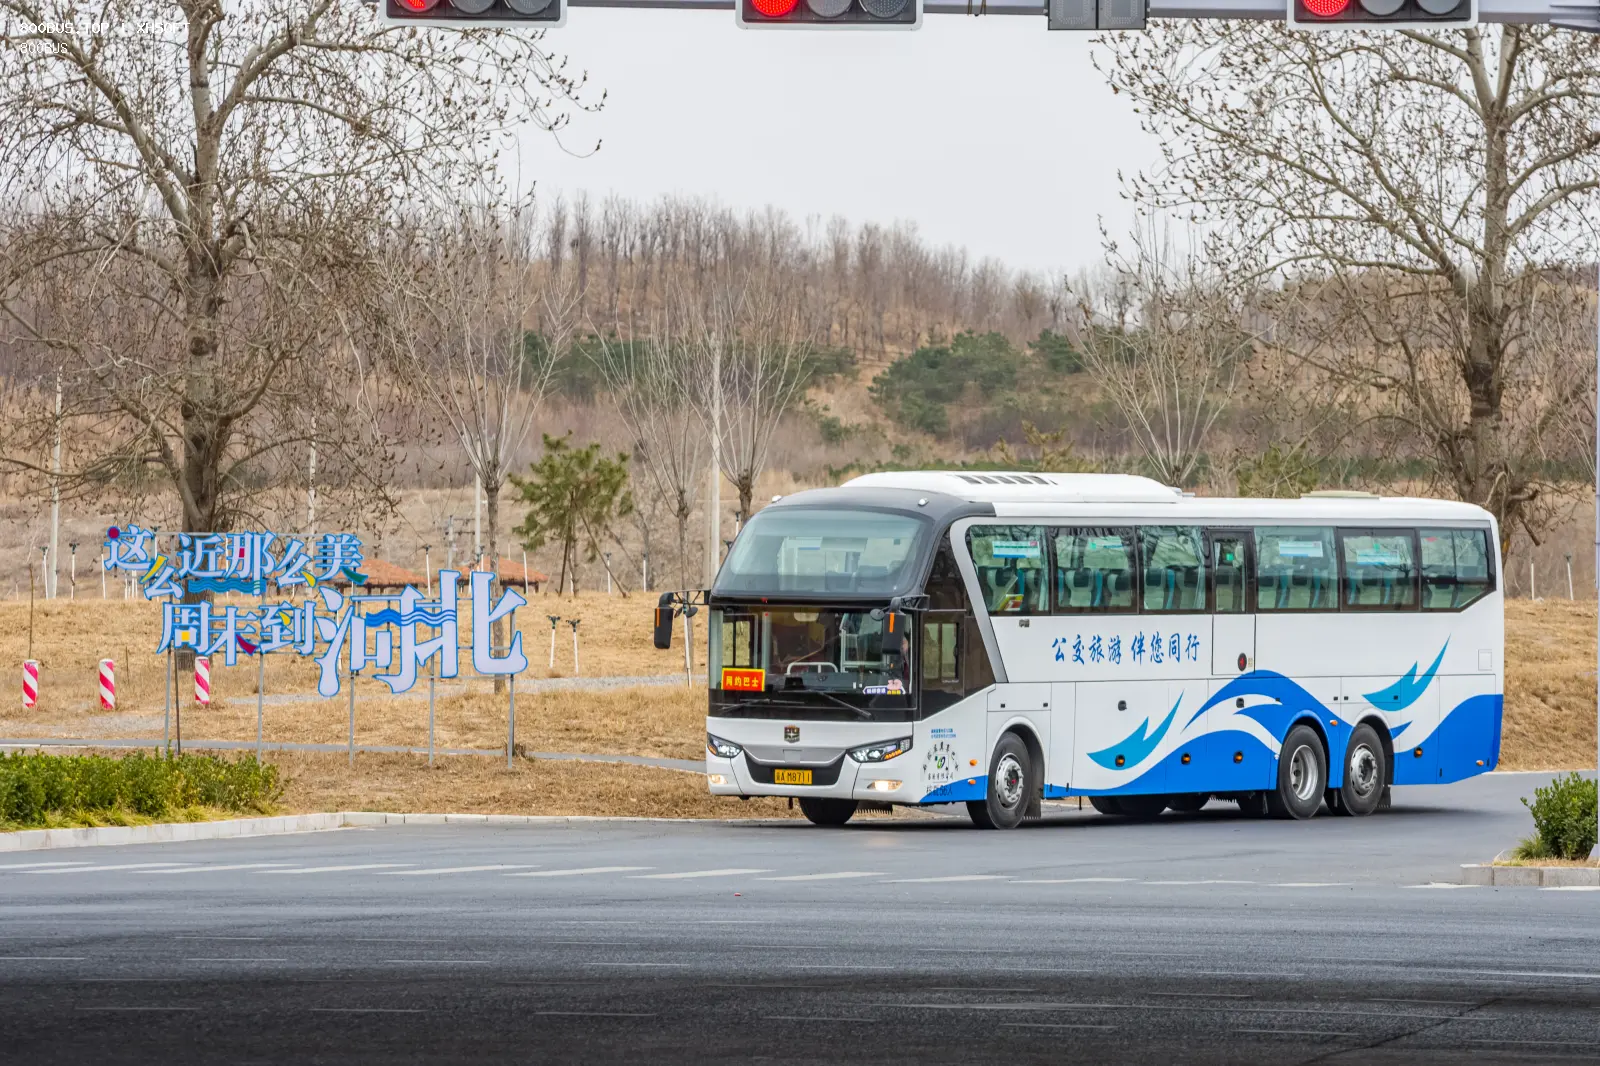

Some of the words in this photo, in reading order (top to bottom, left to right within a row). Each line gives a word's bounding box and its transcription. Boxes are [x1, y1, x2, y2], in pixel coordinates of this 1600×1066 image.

[104, 524, 369, 600] 这么近那么美
[1052, 634, 1122, 665] 公交旅游
[1131, 631, 1200, 666] 伴您同行
